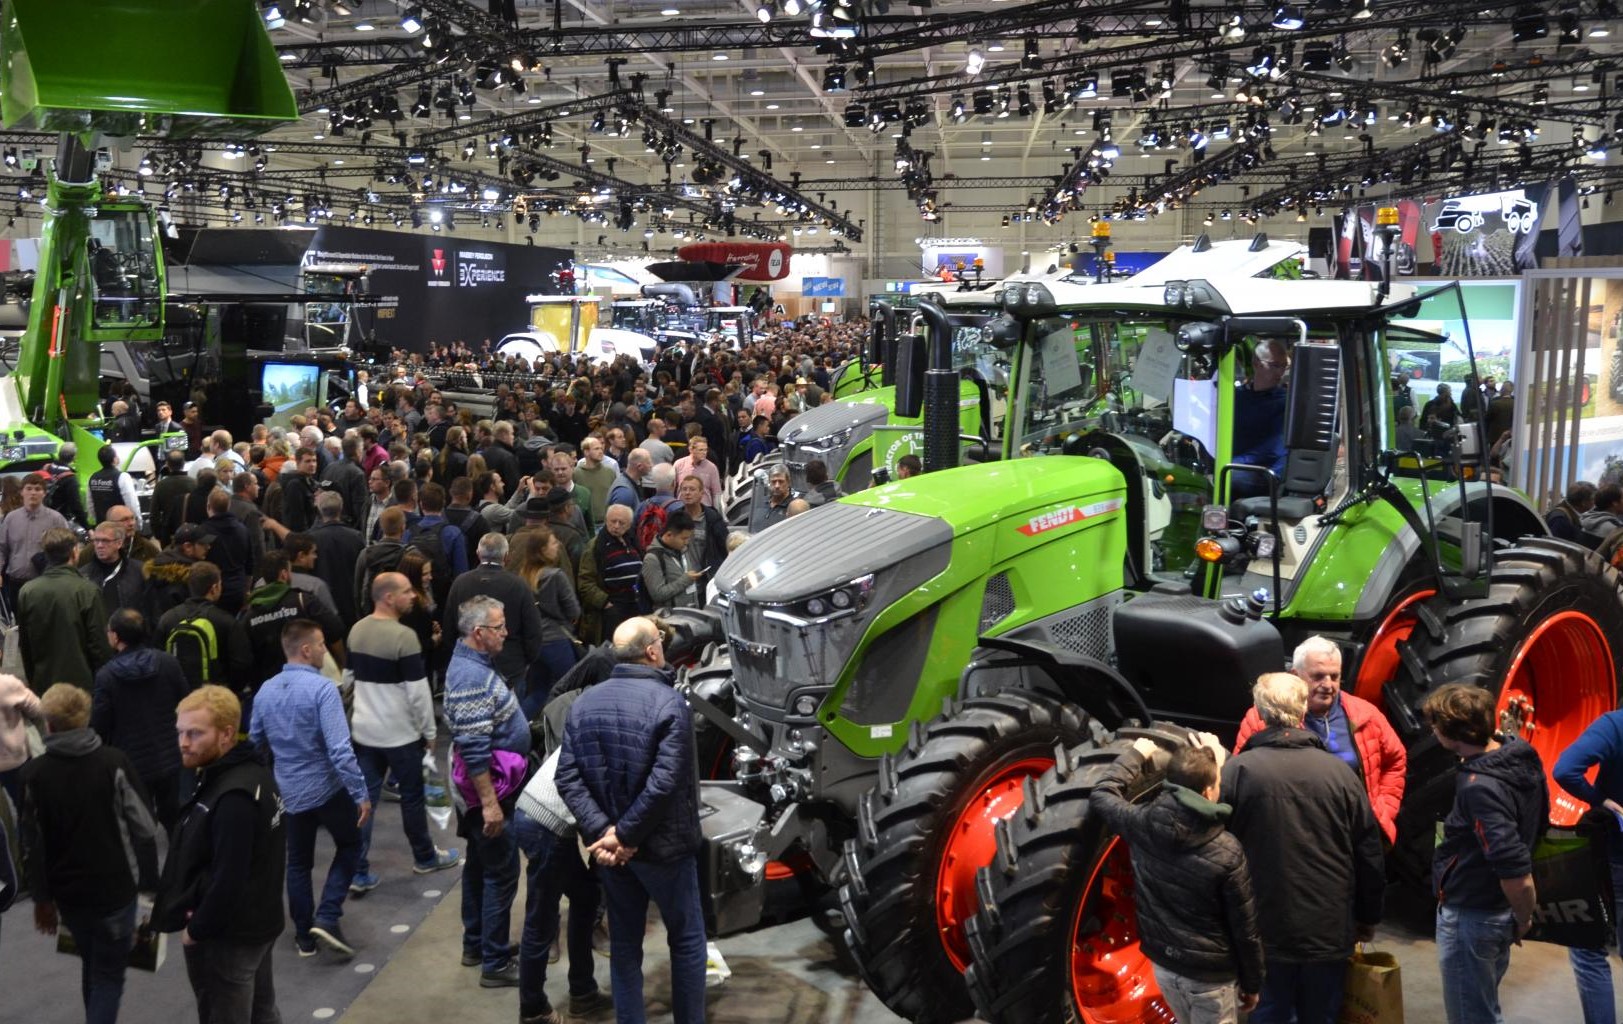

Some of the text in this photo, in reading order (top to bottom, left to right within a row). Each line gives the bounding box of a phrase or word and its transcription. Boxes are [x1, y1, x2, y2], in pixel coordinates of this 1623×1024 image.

[901, 432, 913, 442] OF
[1029, 505, 1075, 533] FENDT
[250, 607, 298, 626] KOMATSU
[1533, 899, 1595, 923] HR
